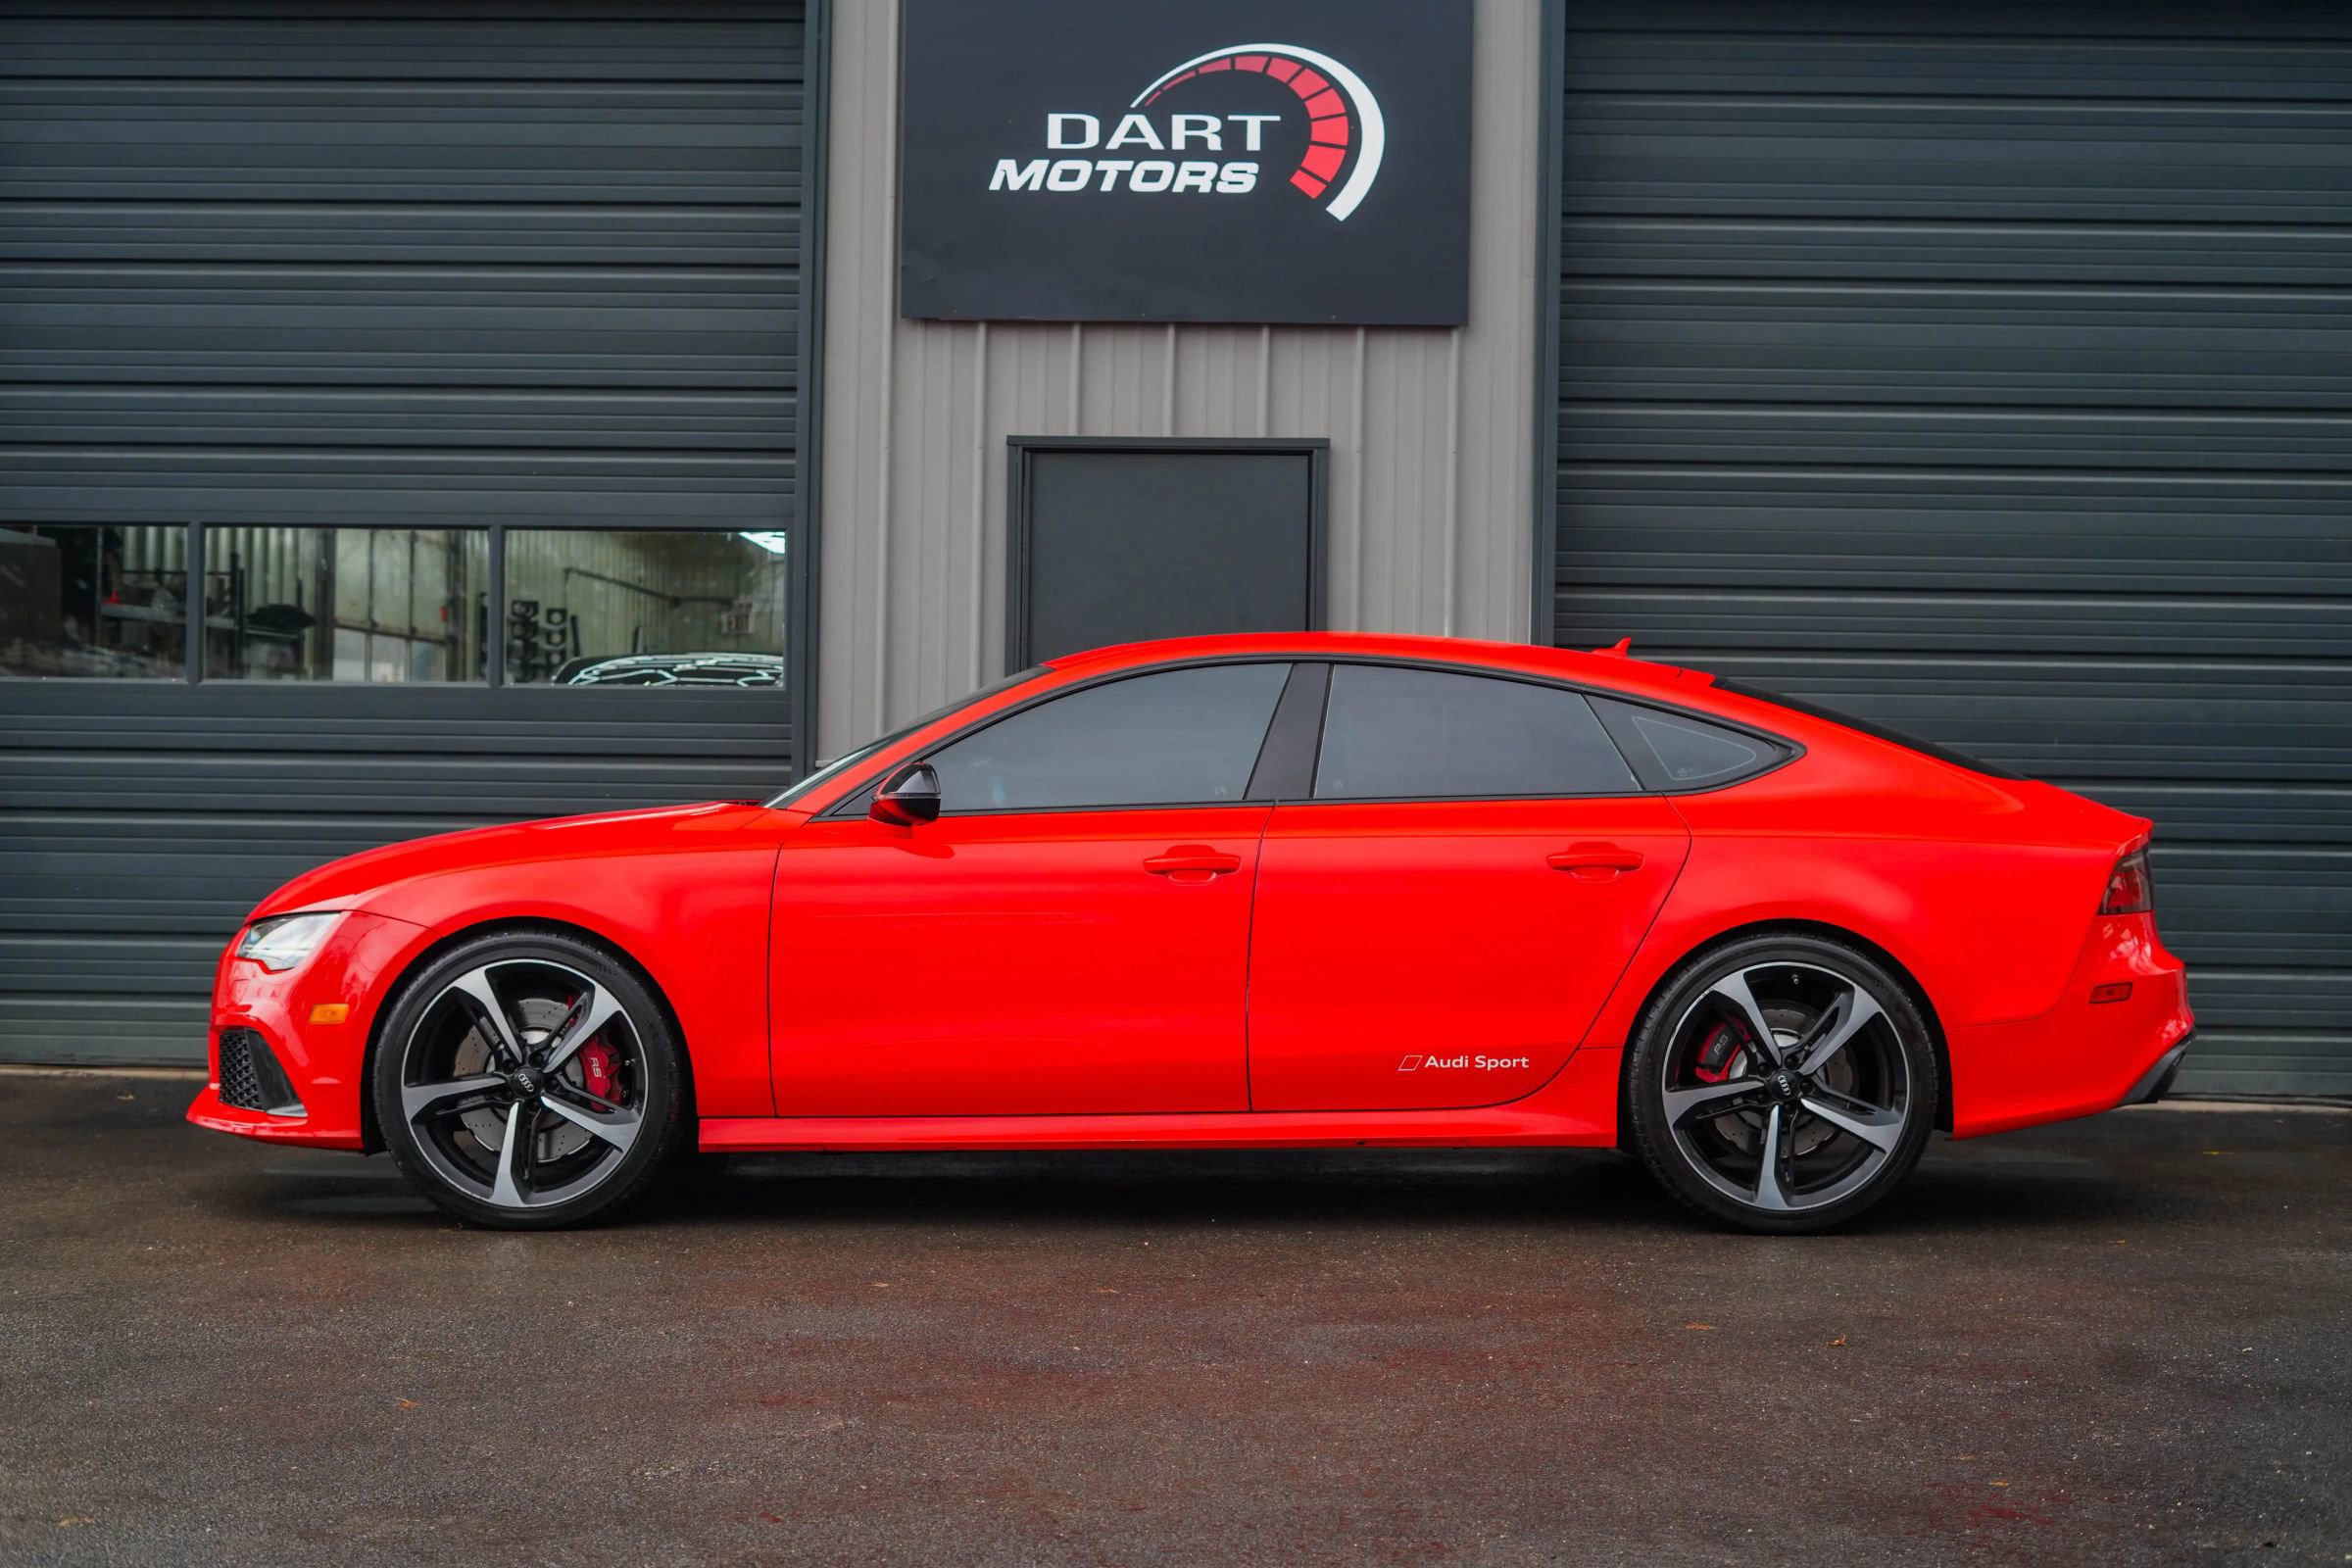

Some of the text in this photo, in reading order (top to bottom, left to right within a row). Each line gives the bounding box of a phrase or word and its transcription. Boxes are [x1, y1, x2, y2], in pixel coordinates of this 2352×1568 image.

[1047, 113, 1281, 151] DART
[988, 159, 1260, 194] MOTORS
[590, 1056, 603, 1078] RS
[1424, 1054, 1530, 1071] Audi Sport
